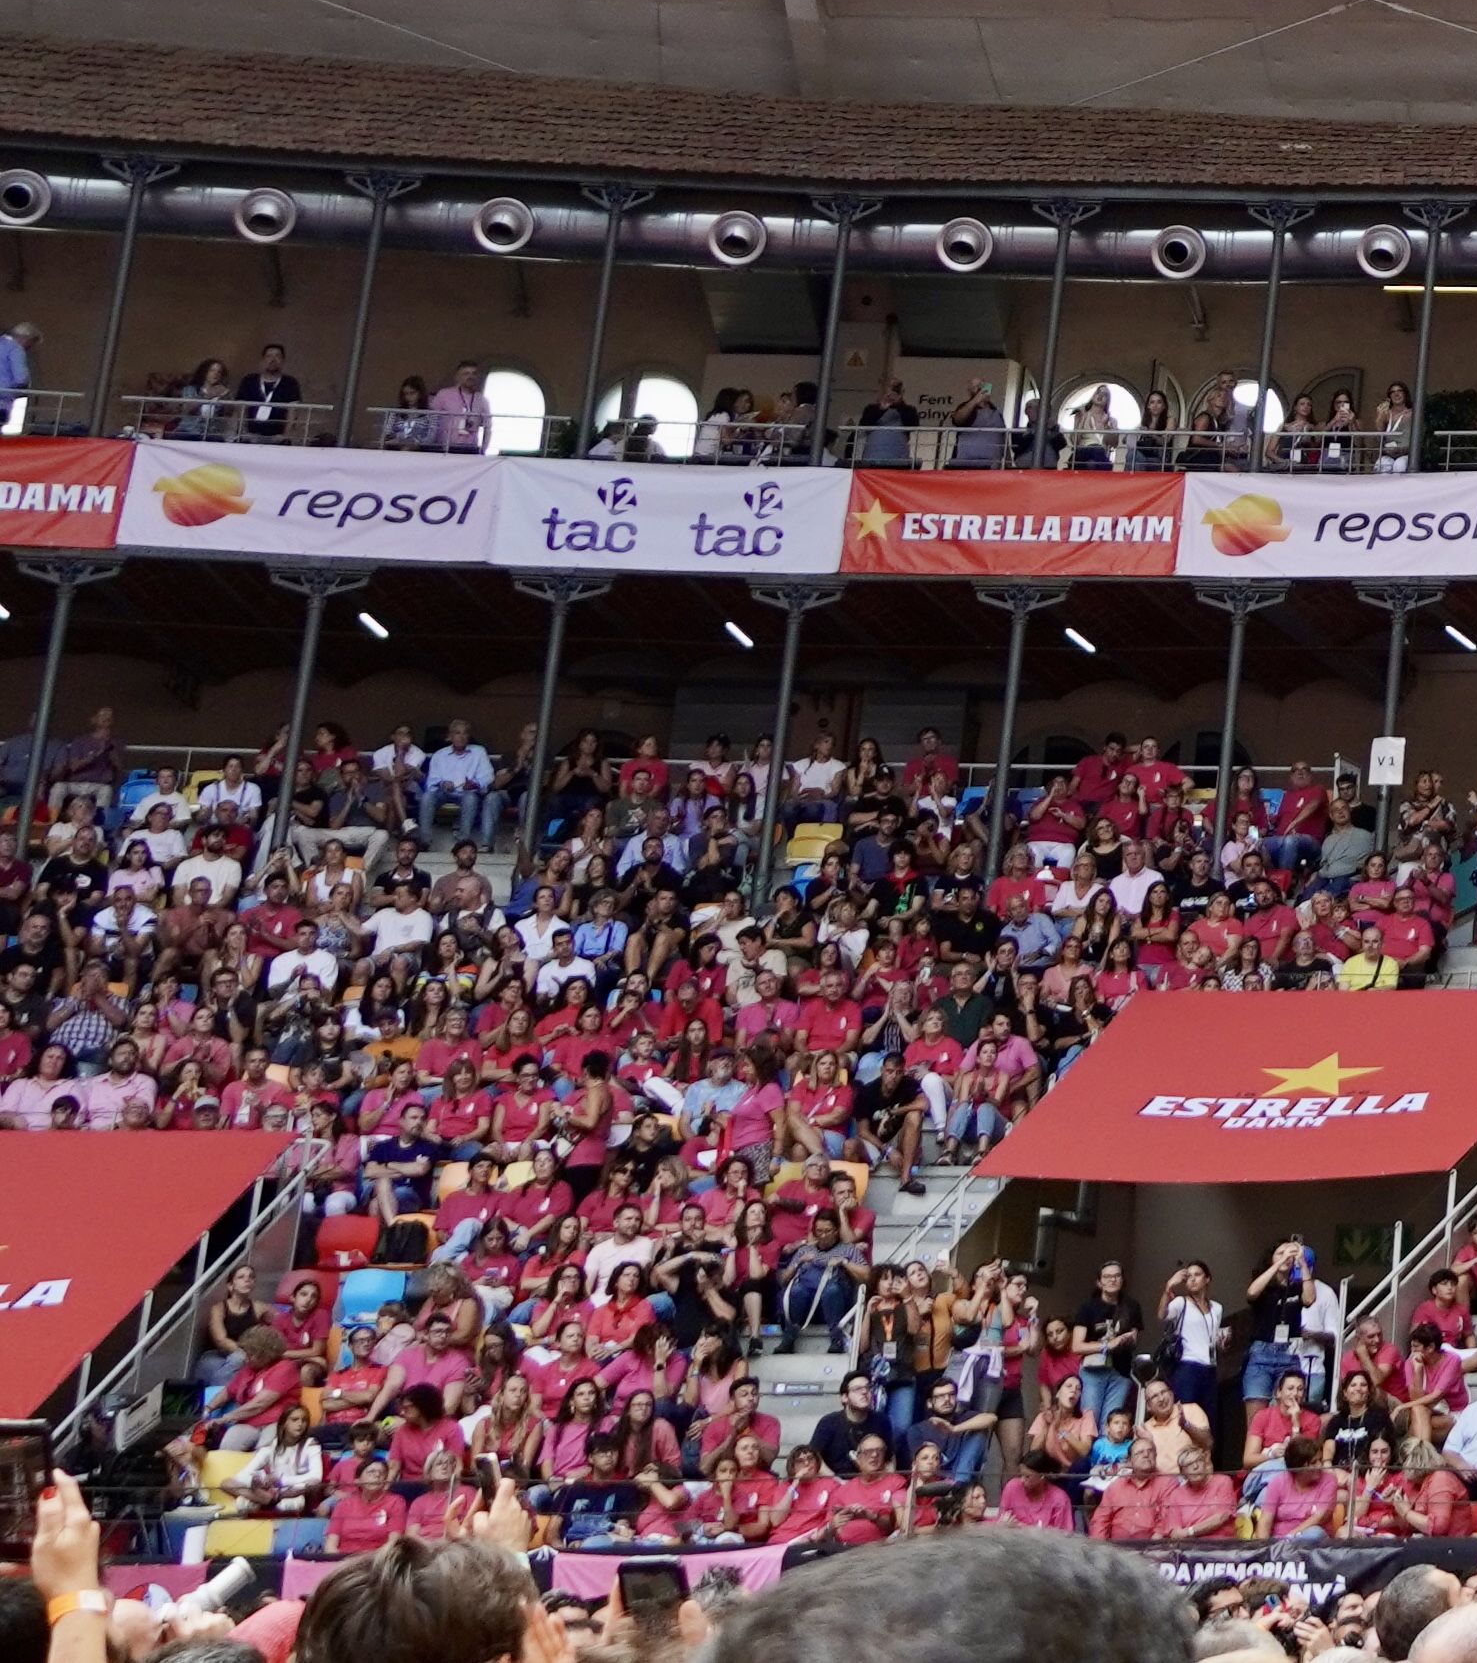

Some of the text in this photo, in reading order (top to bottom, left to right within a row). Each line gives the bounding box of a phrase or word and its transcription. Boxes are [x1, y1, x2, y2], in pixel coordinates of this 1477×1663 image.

[0, 481, 117, 514] DAMM
[278, 488, 479, 528] repsol
[542, 507, 637, 553] tac
[690, 512, 783, 556] tac
[902, 511, 1175, 543] ESTRELLA DAMM
[1138, 1092, 1429, 1118] ESTRELLA
[1221, 1115, 1328, 1129] DAMM
